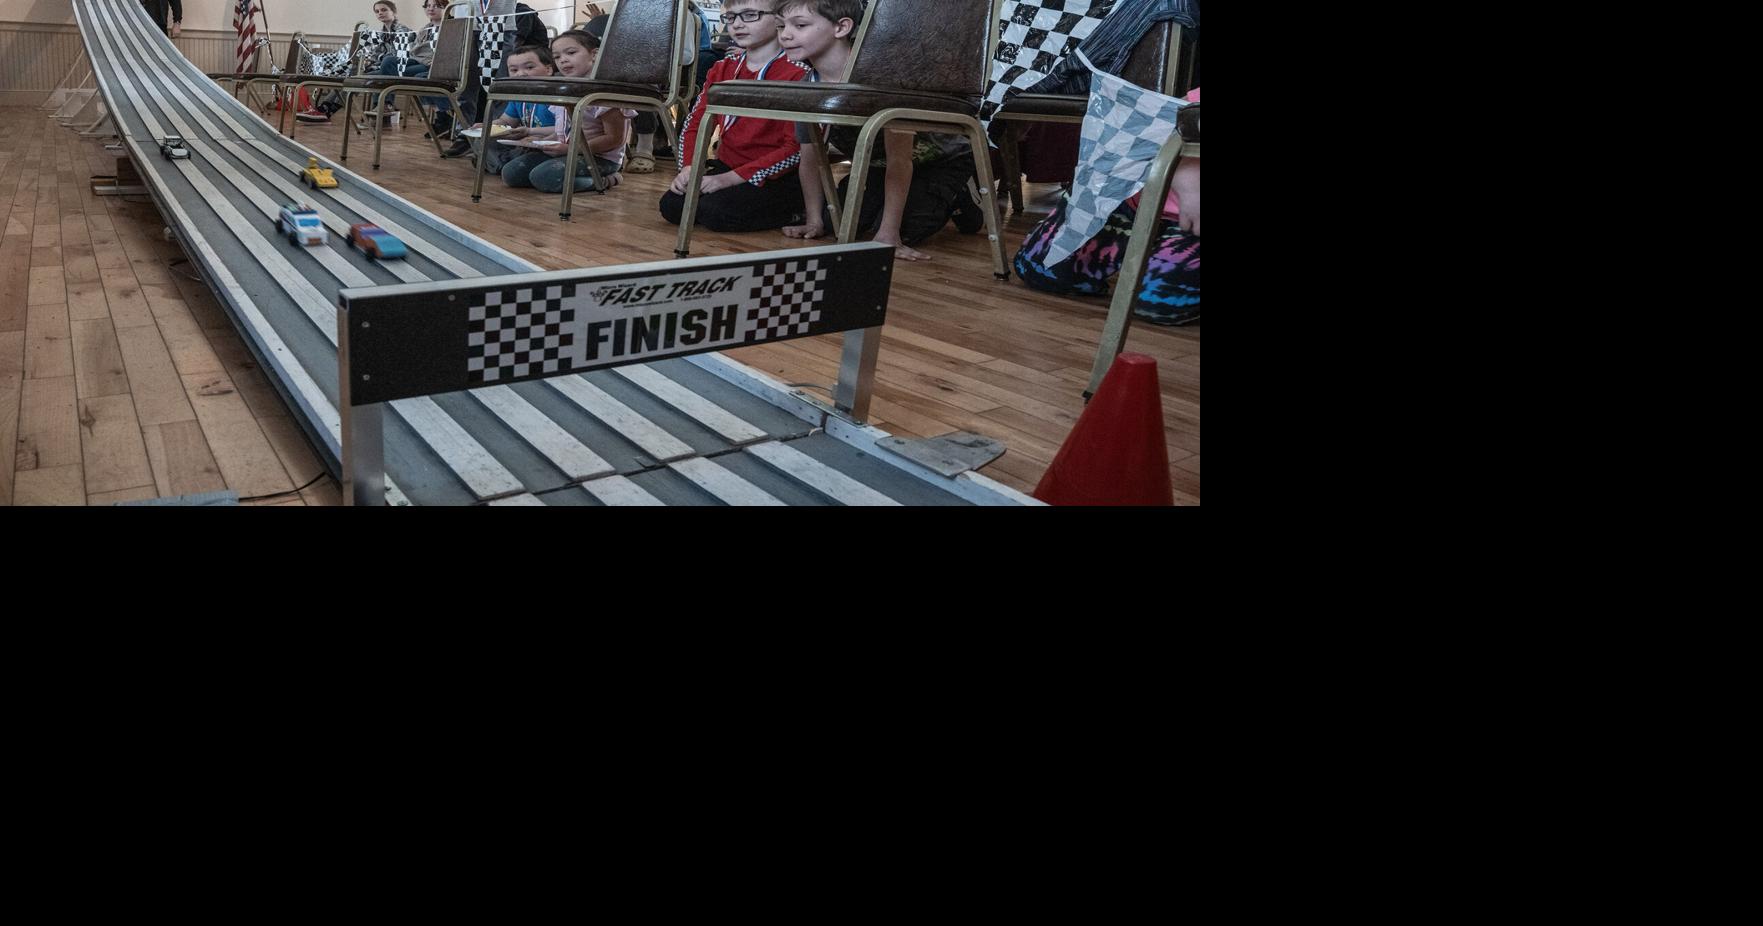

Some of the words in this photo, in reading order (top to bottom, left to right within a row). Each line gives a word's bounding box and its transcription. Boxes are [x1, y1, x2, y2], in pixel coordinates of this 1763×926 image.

[599, 284, 667, 307] FAST
[666, 274, 743, 300] TRACK
[586, 304, 738, 361] FINISH
